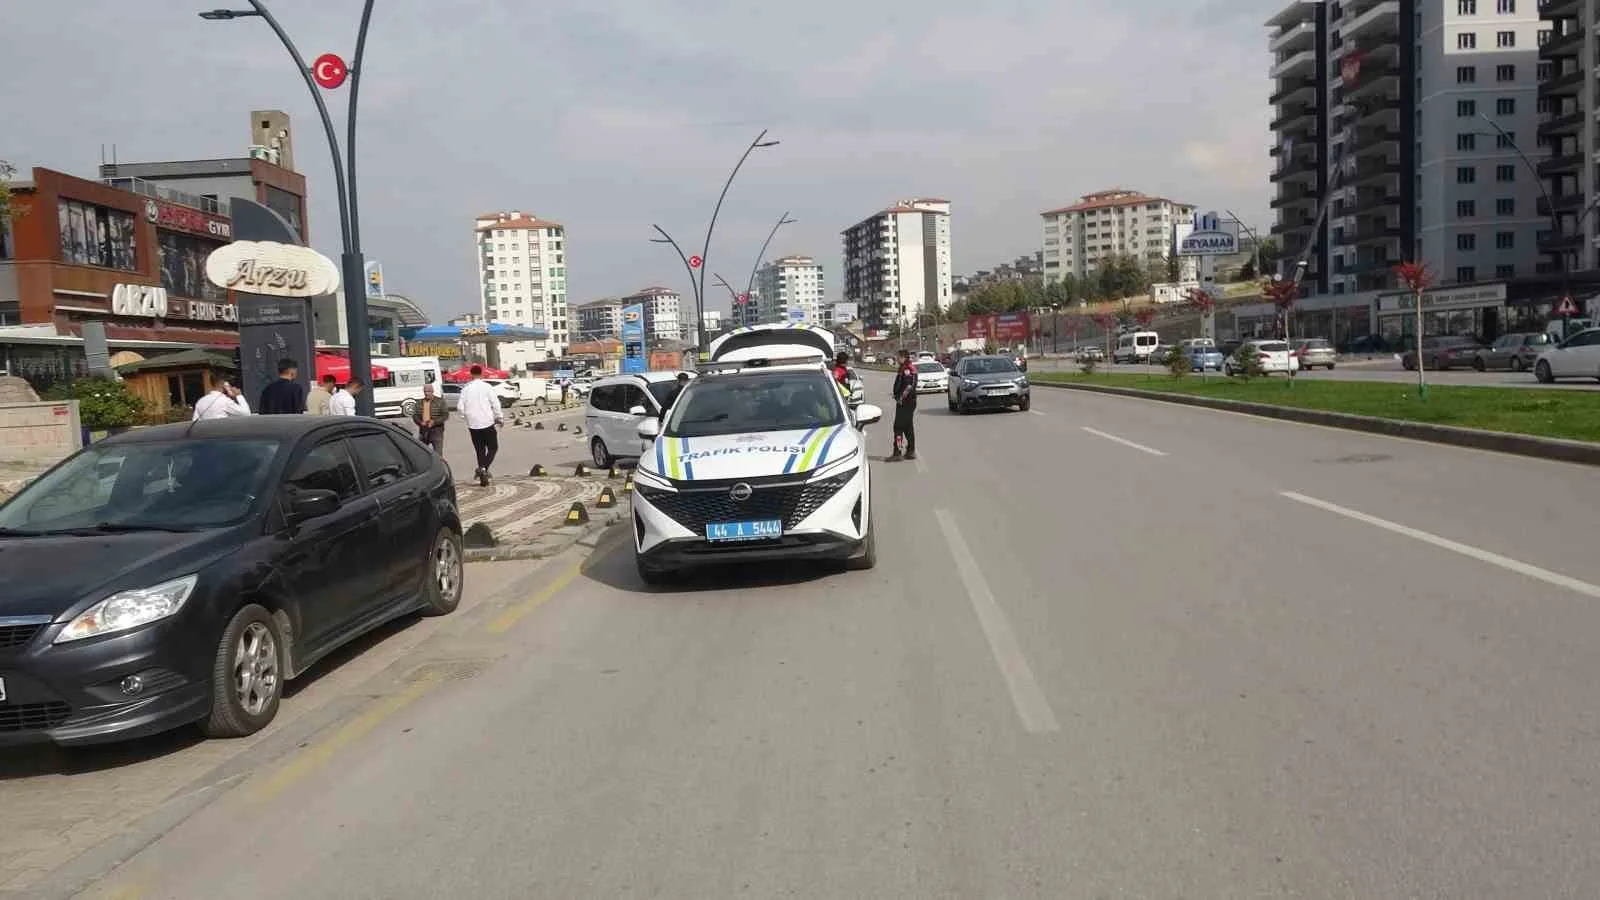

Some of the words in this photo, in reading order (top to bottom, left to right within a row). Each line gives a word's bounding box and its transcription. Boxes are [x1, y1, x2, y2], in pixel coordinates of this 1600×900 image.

[208, 220, 231, 237] GYM
[1183, 238, 1233, 248] ERYAMAN
[227, 259, 307, 289] Arzu
[714, 525, 728, 537] 44
[737, 524, 744, 536] A
[752, 520, 780, 535] 5444
